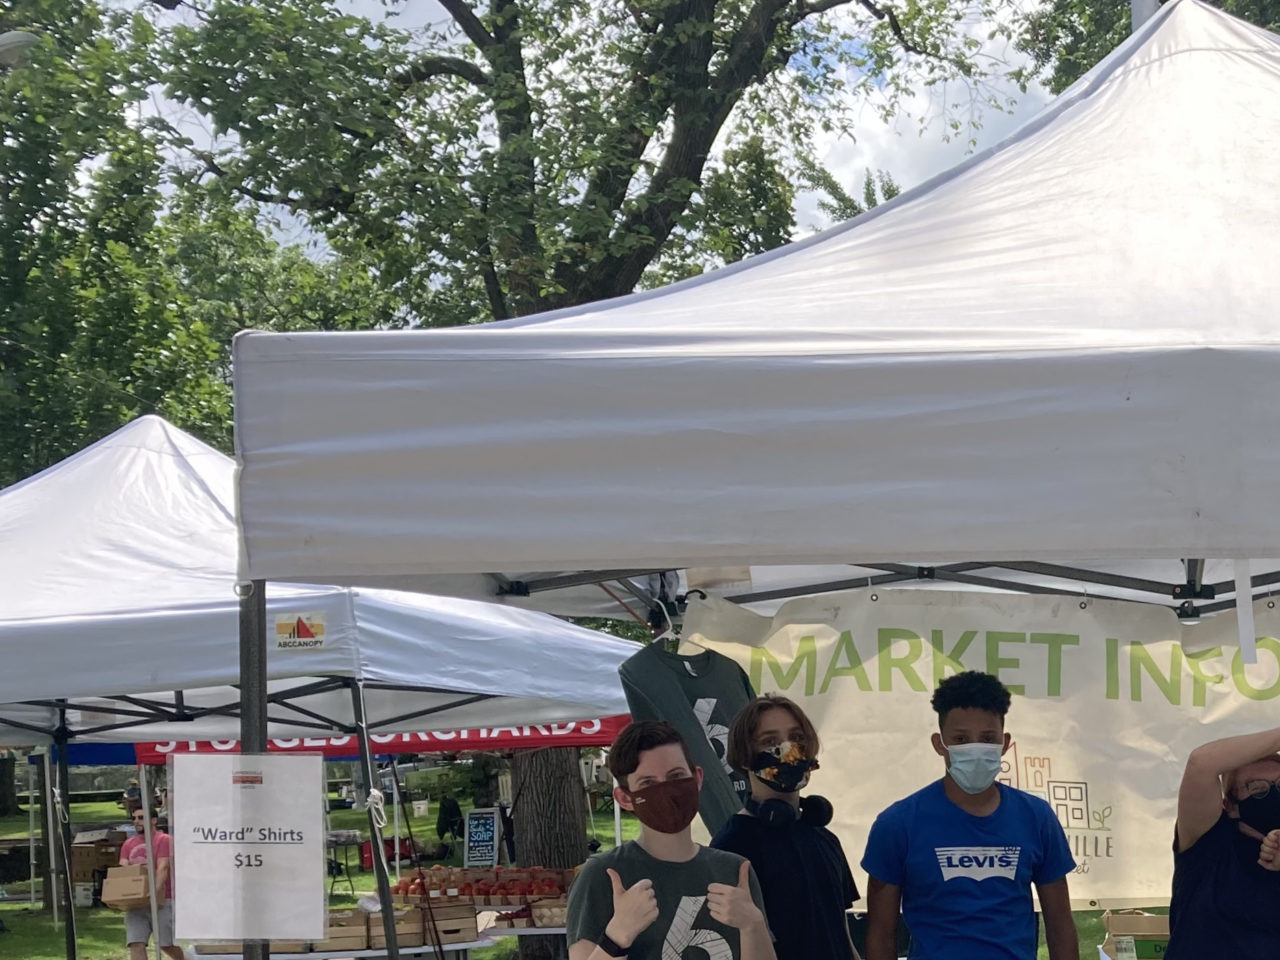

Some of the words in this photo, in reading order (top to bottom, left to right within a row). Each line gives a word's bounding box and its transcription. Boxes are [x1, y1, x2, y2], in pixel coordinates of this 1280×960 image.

[277, 640, 324, 648] ABCCANOPY
[748, 627, 1080, 696] MARKET
[258, 828, 304, 841] Shirts
[234, 853, 263, 869] $15
